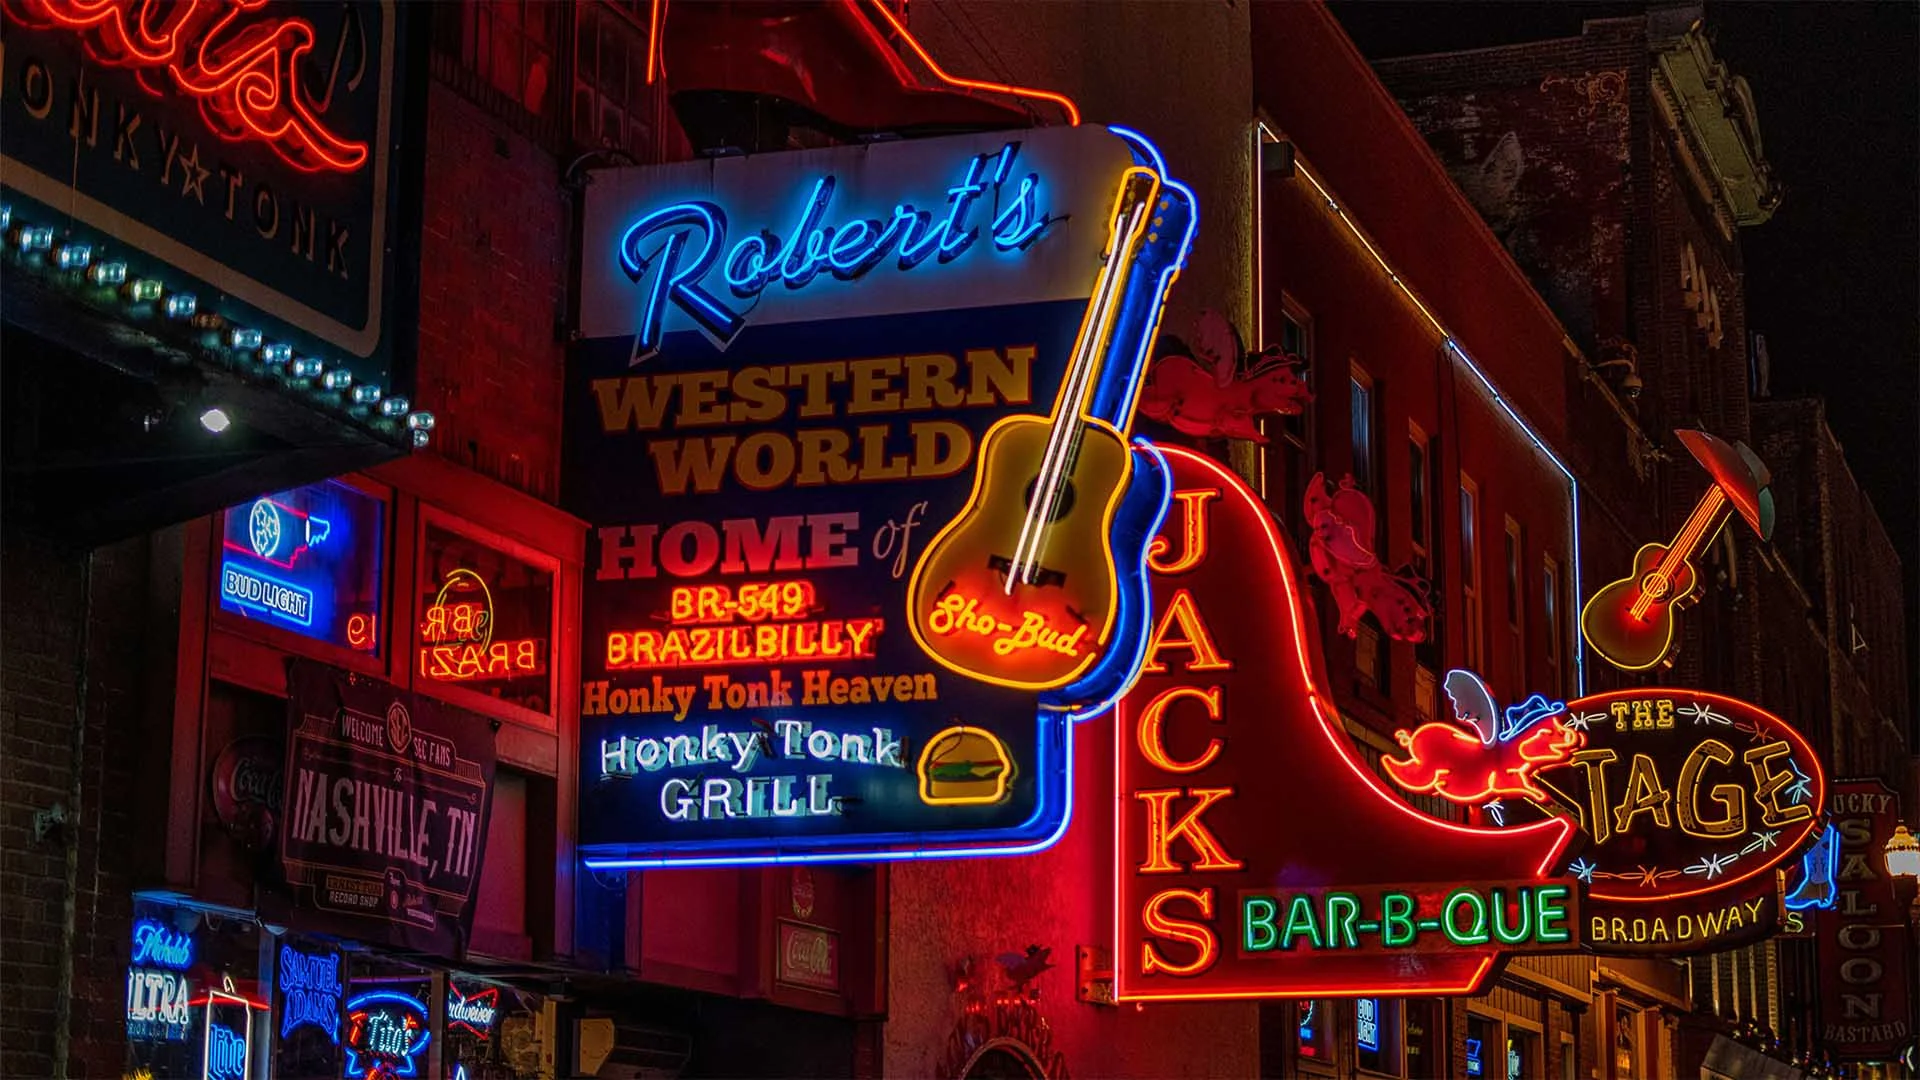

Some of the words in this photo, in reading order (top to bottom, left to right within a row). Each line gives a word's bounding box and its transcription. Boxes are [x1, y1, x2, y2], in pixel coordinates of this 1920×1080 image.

[218, 164, 352, 281] TONK
[618, 141, 1046, 366] Robert's
[591, 345, 1037, 434] WESTERN
[648, 419, 974, 497] WORLD
[596, 510, 861, 581] HOME
[872, 501, 928, 578] of
[225, 571, 260, 602] BUD
[261, 582, 309, 618] LIGHT
[670, 581, 812, 624] BR-549
[606, 619, 882, 669] BRAZILBILLY
[929, 593, 1088, 657] Sho-Bud
[583, 676, 697, 722] Honky
[704, 670, 793, 710] Tonk
[803, 667, 938, 706] Heaven
[1610, 698, 1674, 731] THE
[342, 715, 384, 748] WELCOME
[413, 736, 428, 761] SEC
[430, 742, 451, 768] FANS
[601, 724, 759, 778] Honky
[777, 720, 907, 769] Tonk
[1137, 488, 1243, 976] JACKS
[291, 767, 440, 879] NASHVILLE,
[444, 807, 478, 878] TN
[661, 774, 839, 822] GRILL
[1832, 791, 1891, 817] UCKY
[1243, 885, 1569, 951] BAR-B-QUE
[1591, 897, 1764, 943] BROADWAY
[1837, 818, 1884, 1019] SALOON
[280, 945, 342, 997] SAMUEL
[281, 988, 340, 1041] ADAMS
[1824, 1019, 1907, 1043] BASTARD
[210, 1023, 246, 1078] Lite
